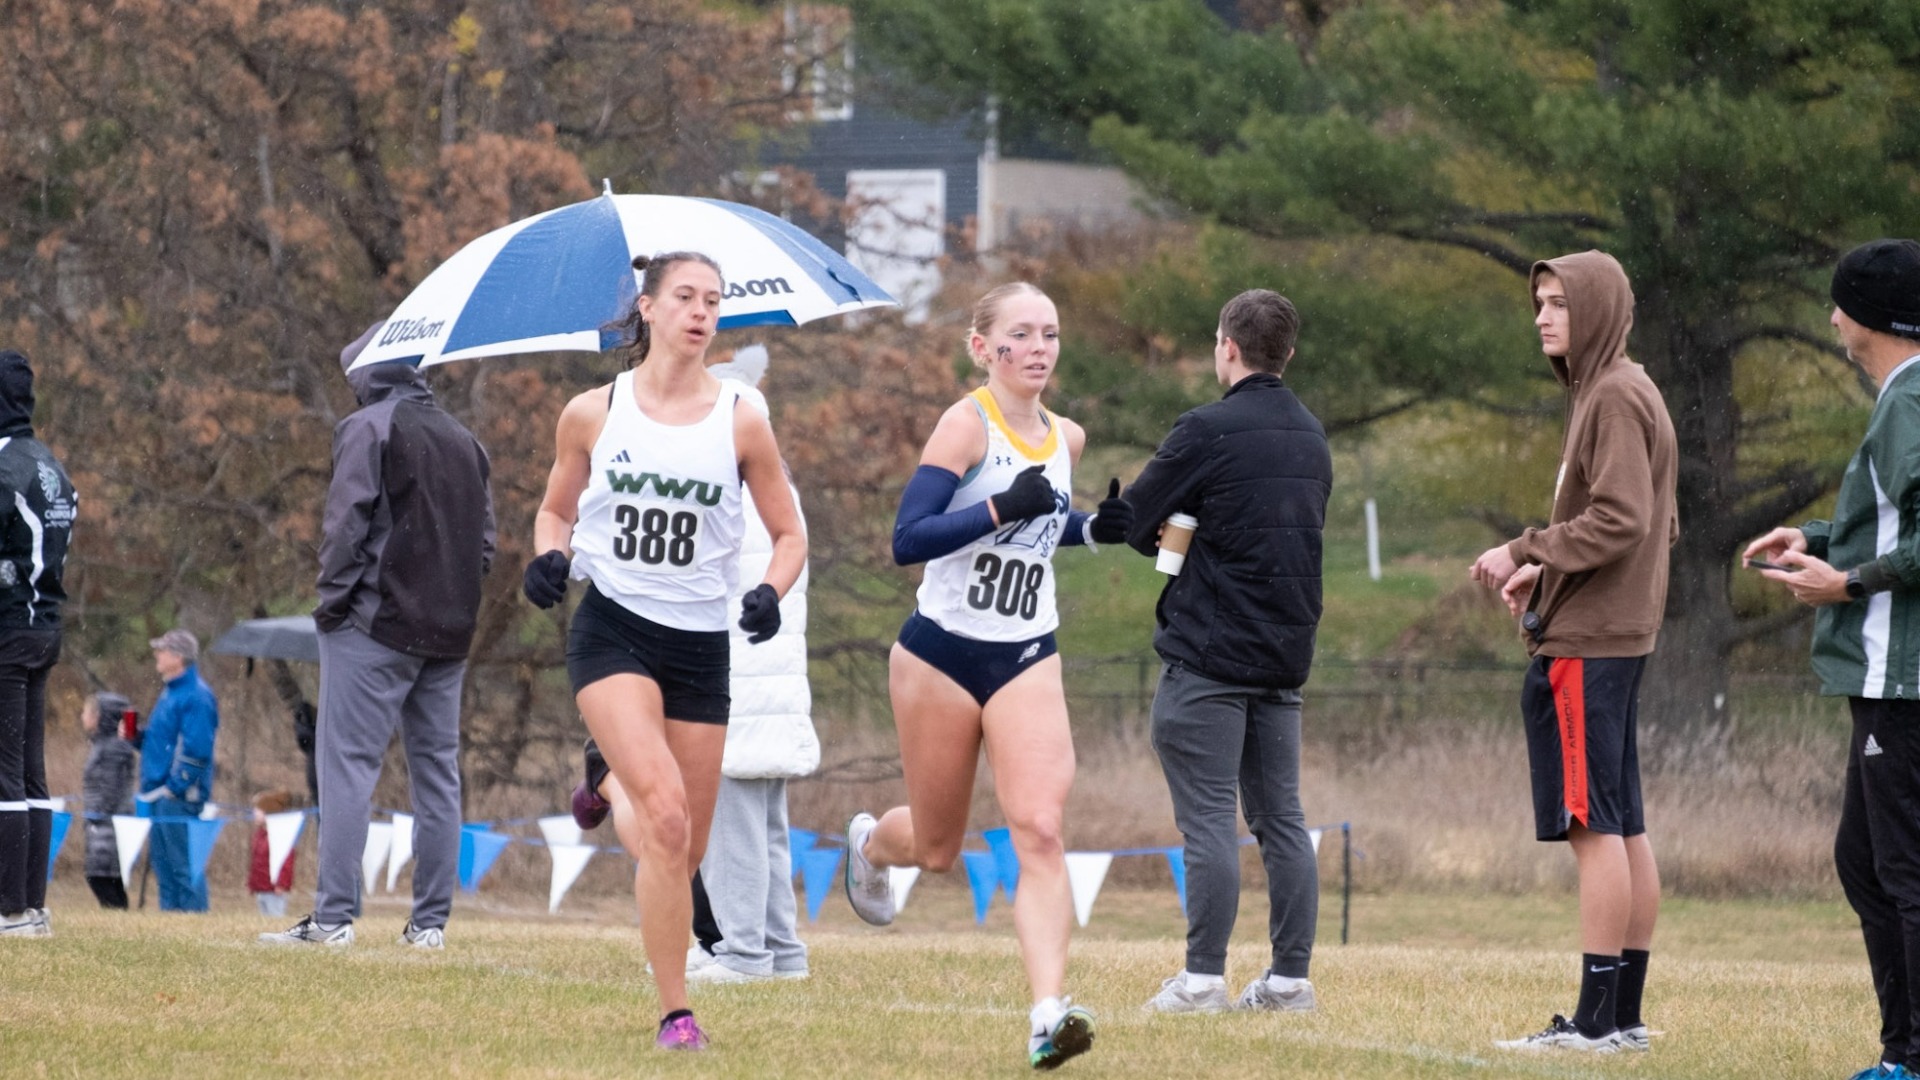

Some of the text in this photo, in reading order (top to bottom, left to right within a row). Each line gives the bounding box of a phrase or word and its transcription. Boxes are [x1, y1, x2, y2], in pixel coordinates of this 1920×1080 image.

[721, 277, 795, 299] son
[378, 316, 446, 348] Wilson
[605, 469, 723, 507] WWU
[613, 504, 698, 568] 388
[967, 553, 1045, 621] 308
